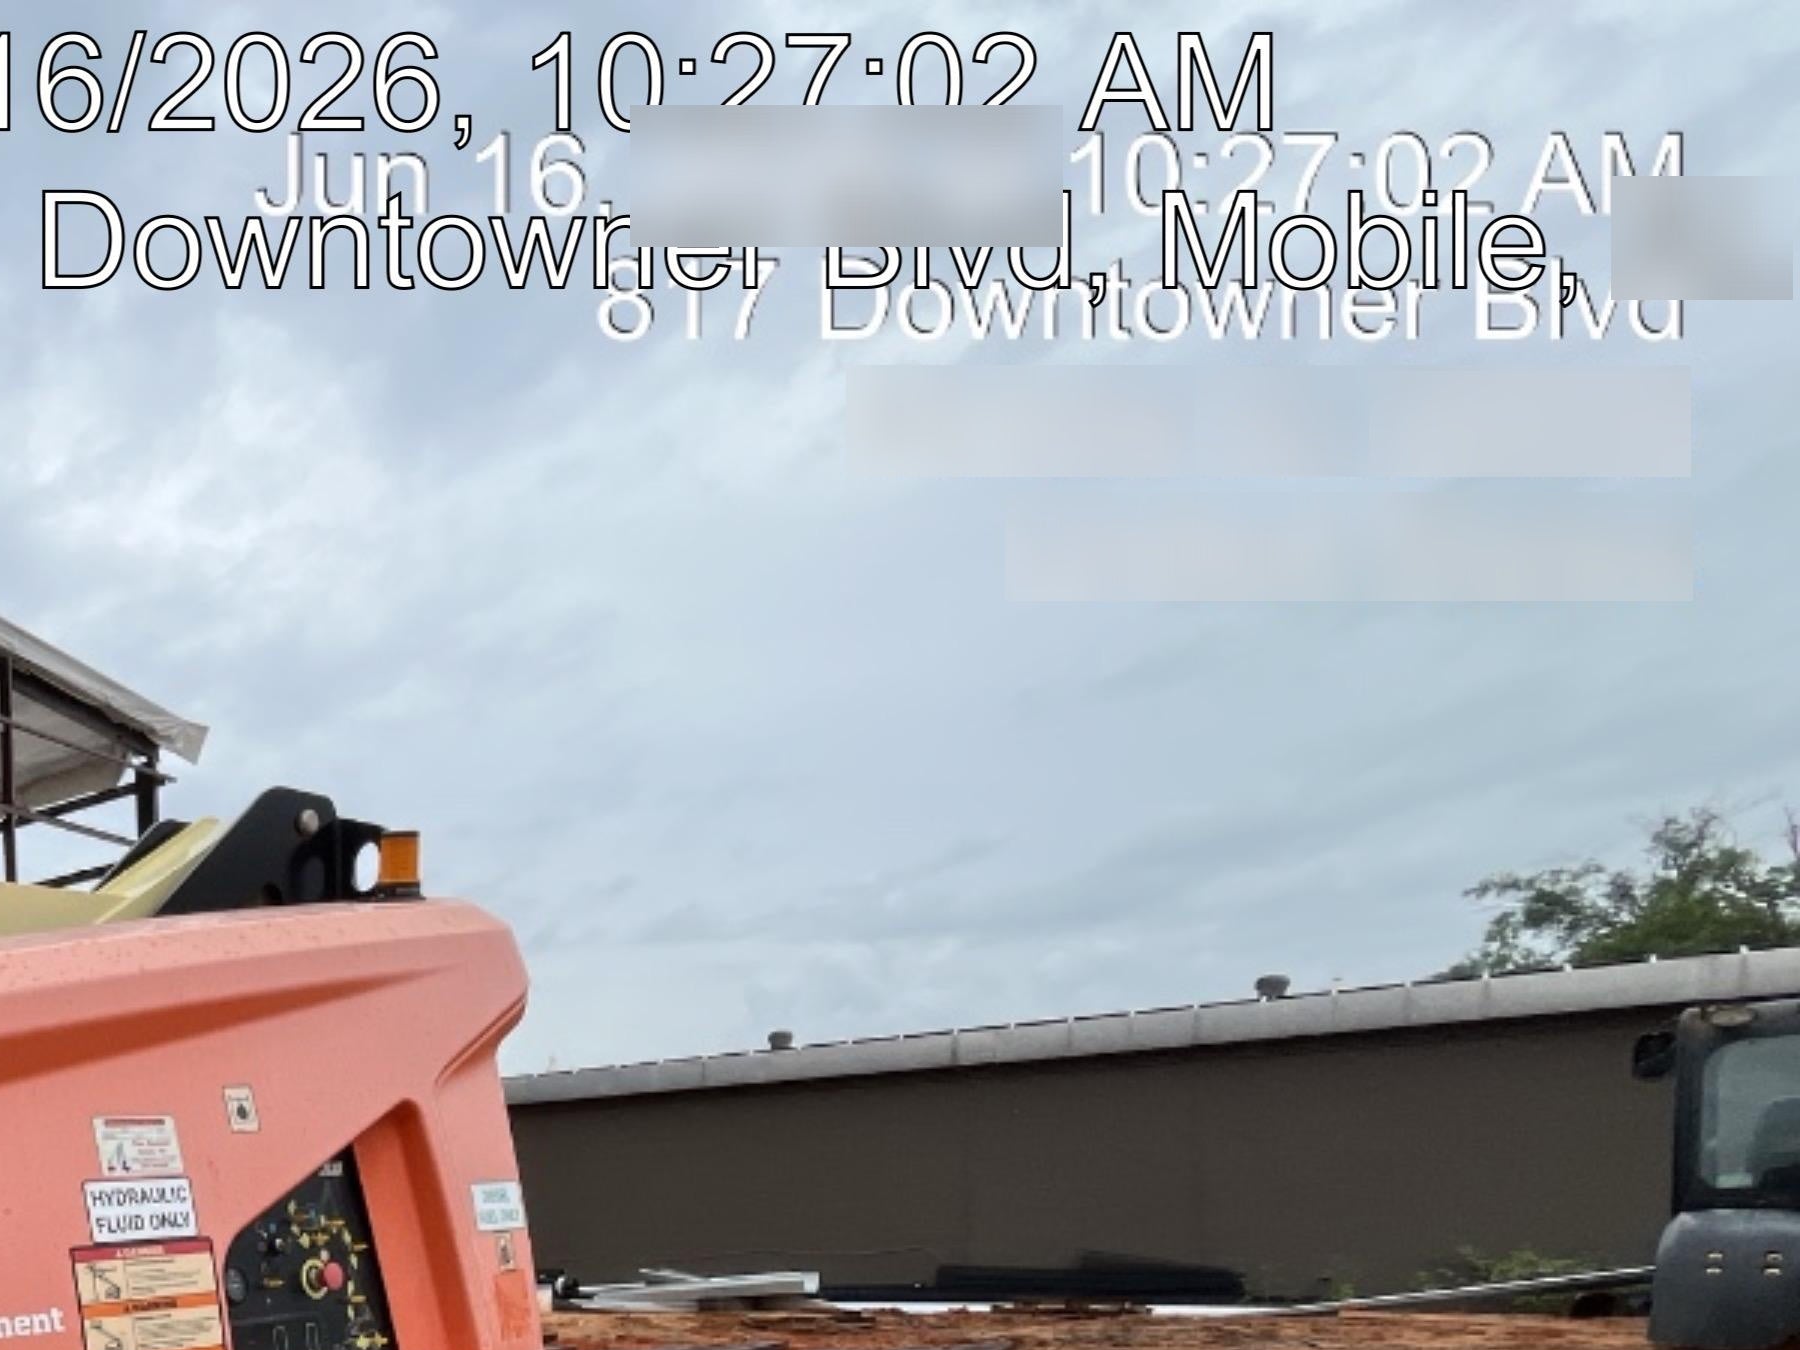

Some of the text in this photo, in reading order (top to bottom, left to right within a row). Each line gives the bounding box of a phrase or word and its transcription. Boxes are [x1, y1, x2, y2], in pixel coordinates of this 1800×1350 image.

[89, 1184, 188, 1208] HYDRAULIC
[94, 1211, 191, 1234] FLUID ONLY
